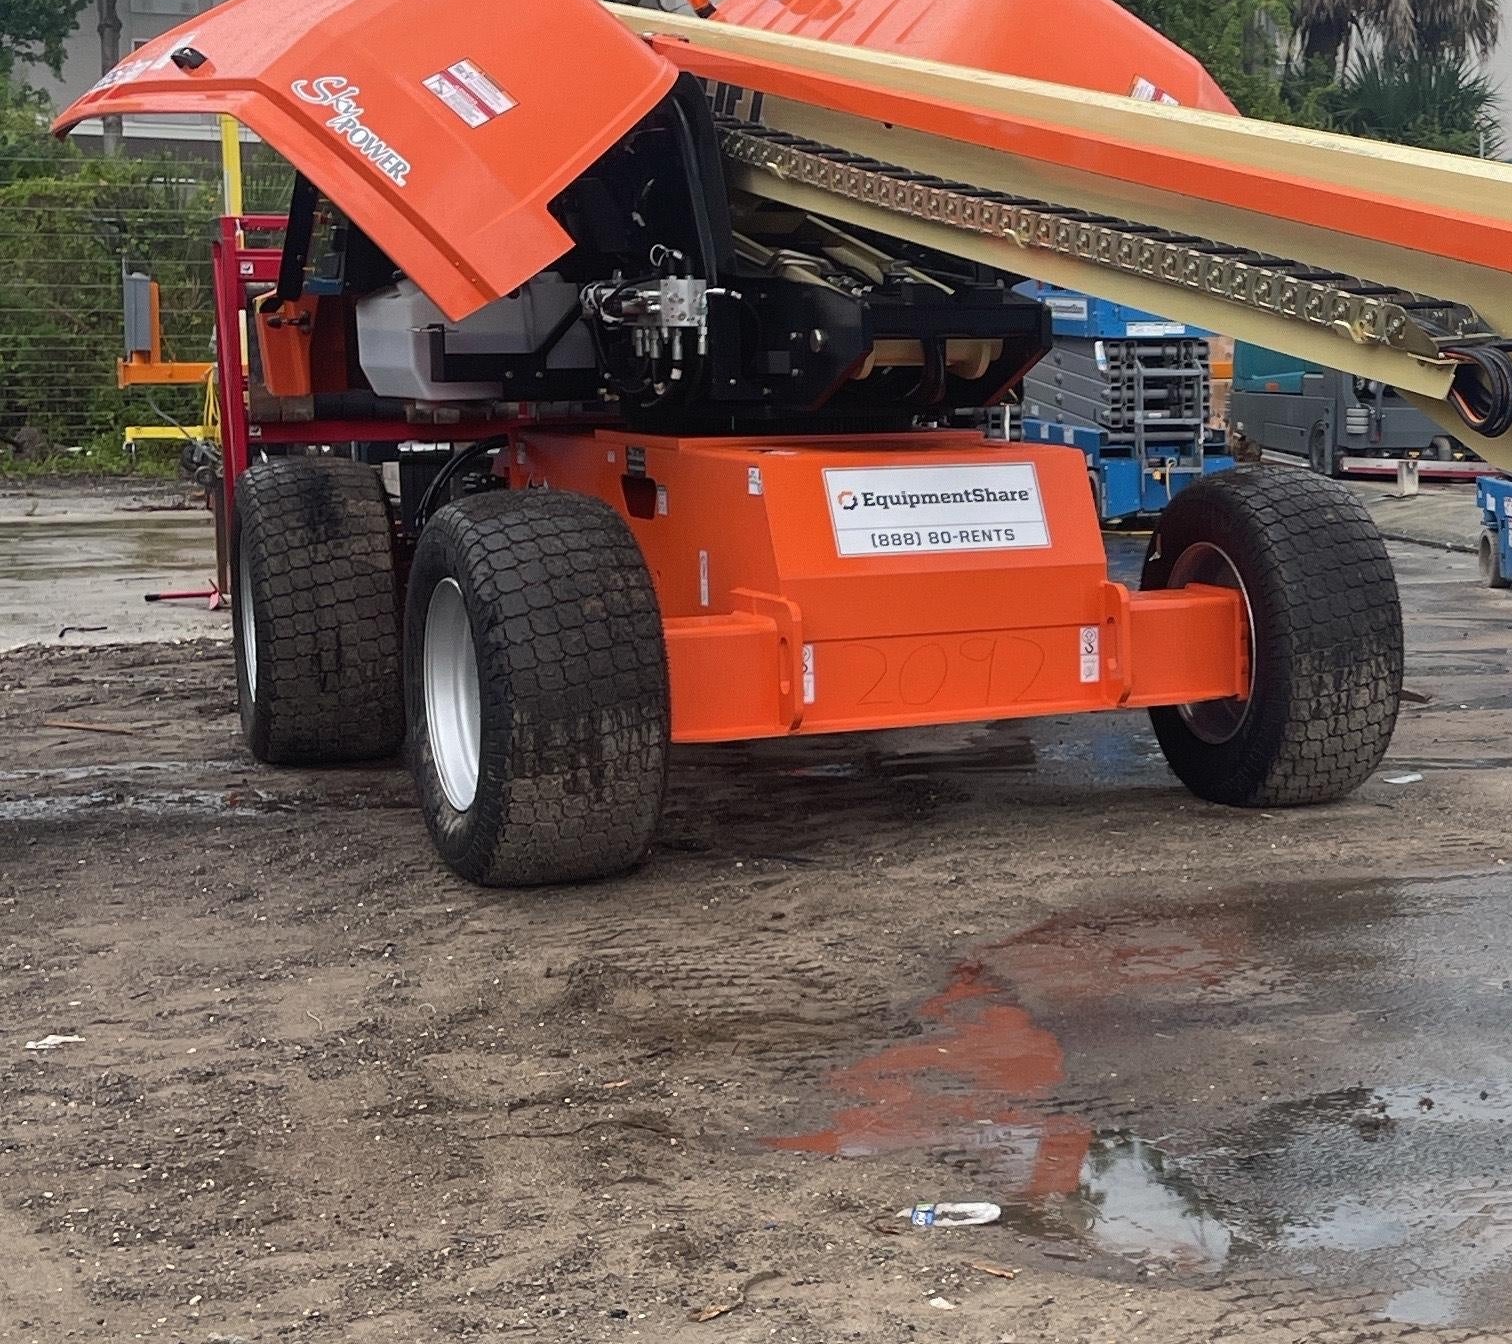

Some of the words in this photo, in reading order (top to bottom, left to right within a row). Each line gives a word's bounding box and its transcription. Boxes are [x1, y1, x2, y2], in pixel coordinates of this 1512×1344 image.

[860, 487, 1031, 510] EquipmentShare
[870, 531, 922, 548] (888)
[928, 528, 1016, 545] 80-RENTS
[842, 635, 1066, 706] 2092
